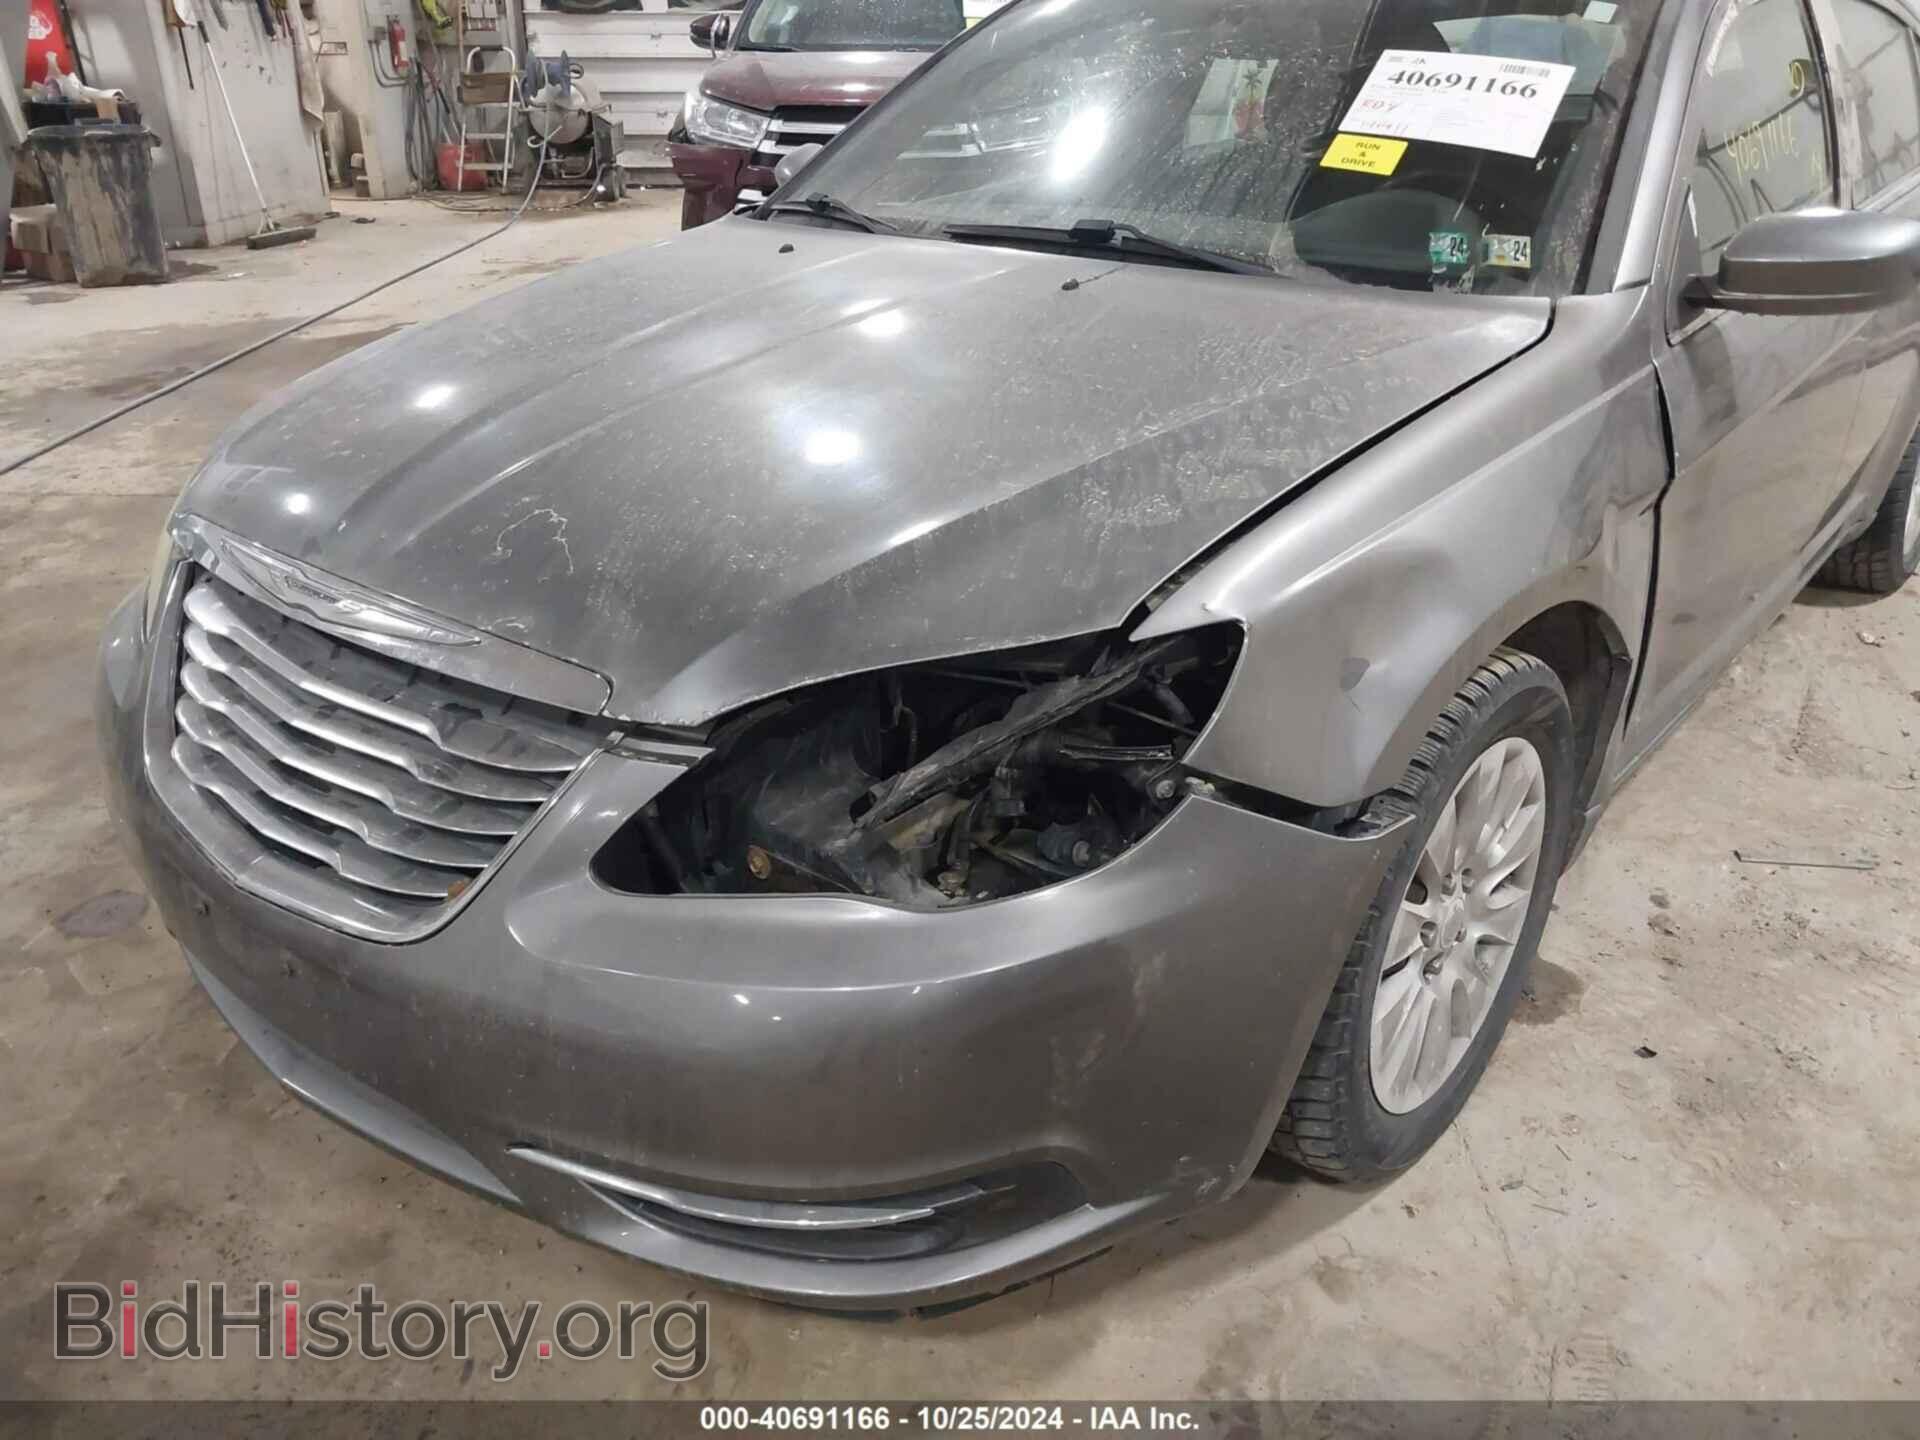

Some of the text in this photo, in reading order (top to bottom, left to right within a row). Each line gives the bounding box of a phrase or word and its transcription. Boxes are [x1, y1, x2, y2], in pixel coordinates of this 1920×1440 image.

[1387, 69, 1538, 99] 40691166
[1355, 141, 1382, 151] RUN
[1341, 157, 1377, 168] DRIVE
[1449, 236, 1465, 257] 24
[1513, 240, 1528, 262] 24
